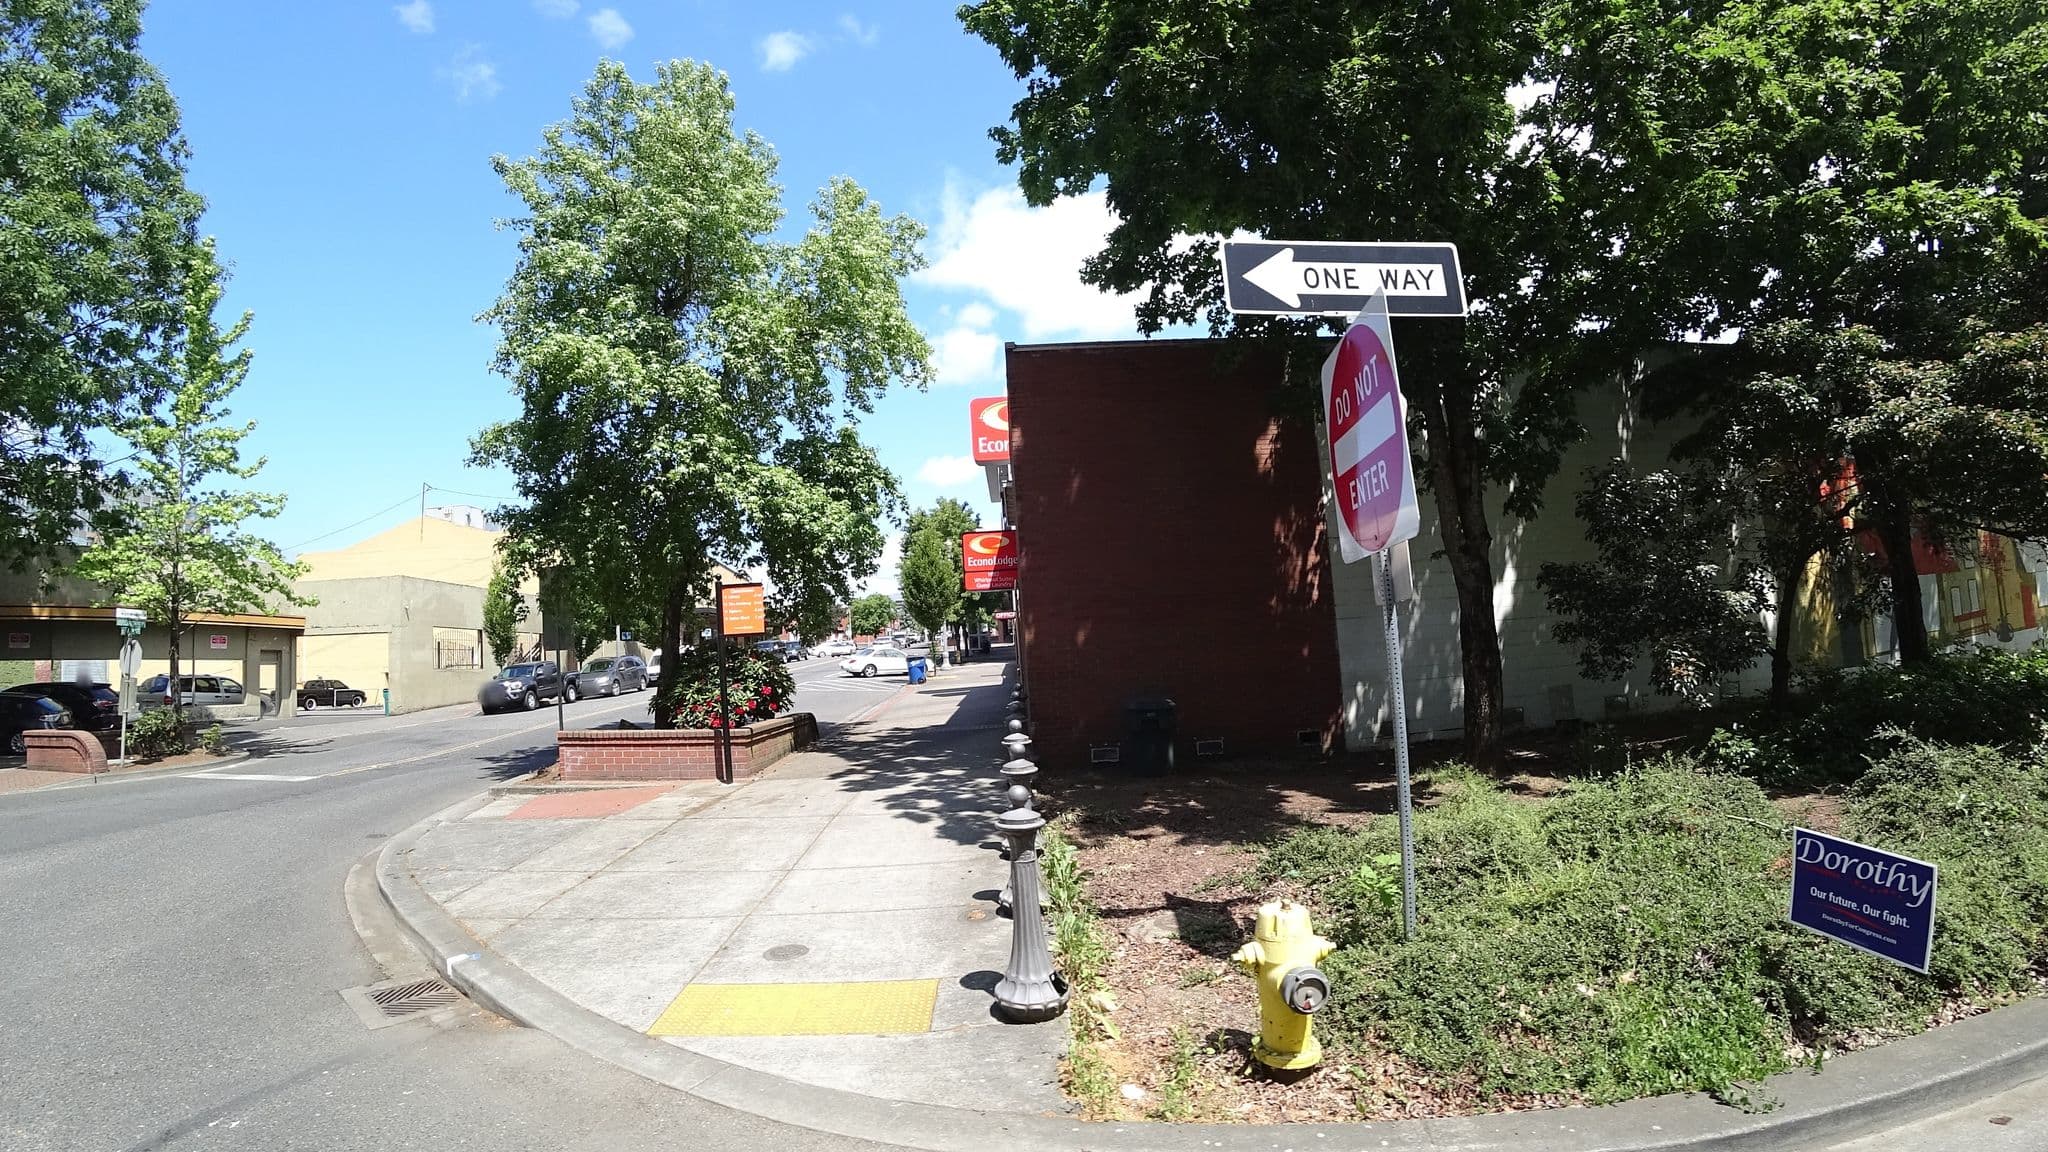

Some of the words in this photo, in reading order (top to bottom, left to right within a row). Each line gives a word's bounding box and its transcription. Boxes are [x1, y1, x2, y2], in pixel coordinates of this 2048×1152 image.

[1303, 267, 1360, 290] ONE
[1379, 268, 1434, 291] WAY
[1335, 389, 1351, 425] DO
[1354, 354, 1379, 406] NOT
[1348, 458, 1390, 512] ENTER
[1797, 837, 1932, 908] Dorothy
[1810, 886, 1828, 900] Our
[1828, 891, 1860, 911] future.
[1862, 903, 1881, 918] Our
[1882, 910, 1911, 928] fight.
[1821, 913, 1898, 945] DorothyForCongress.com
